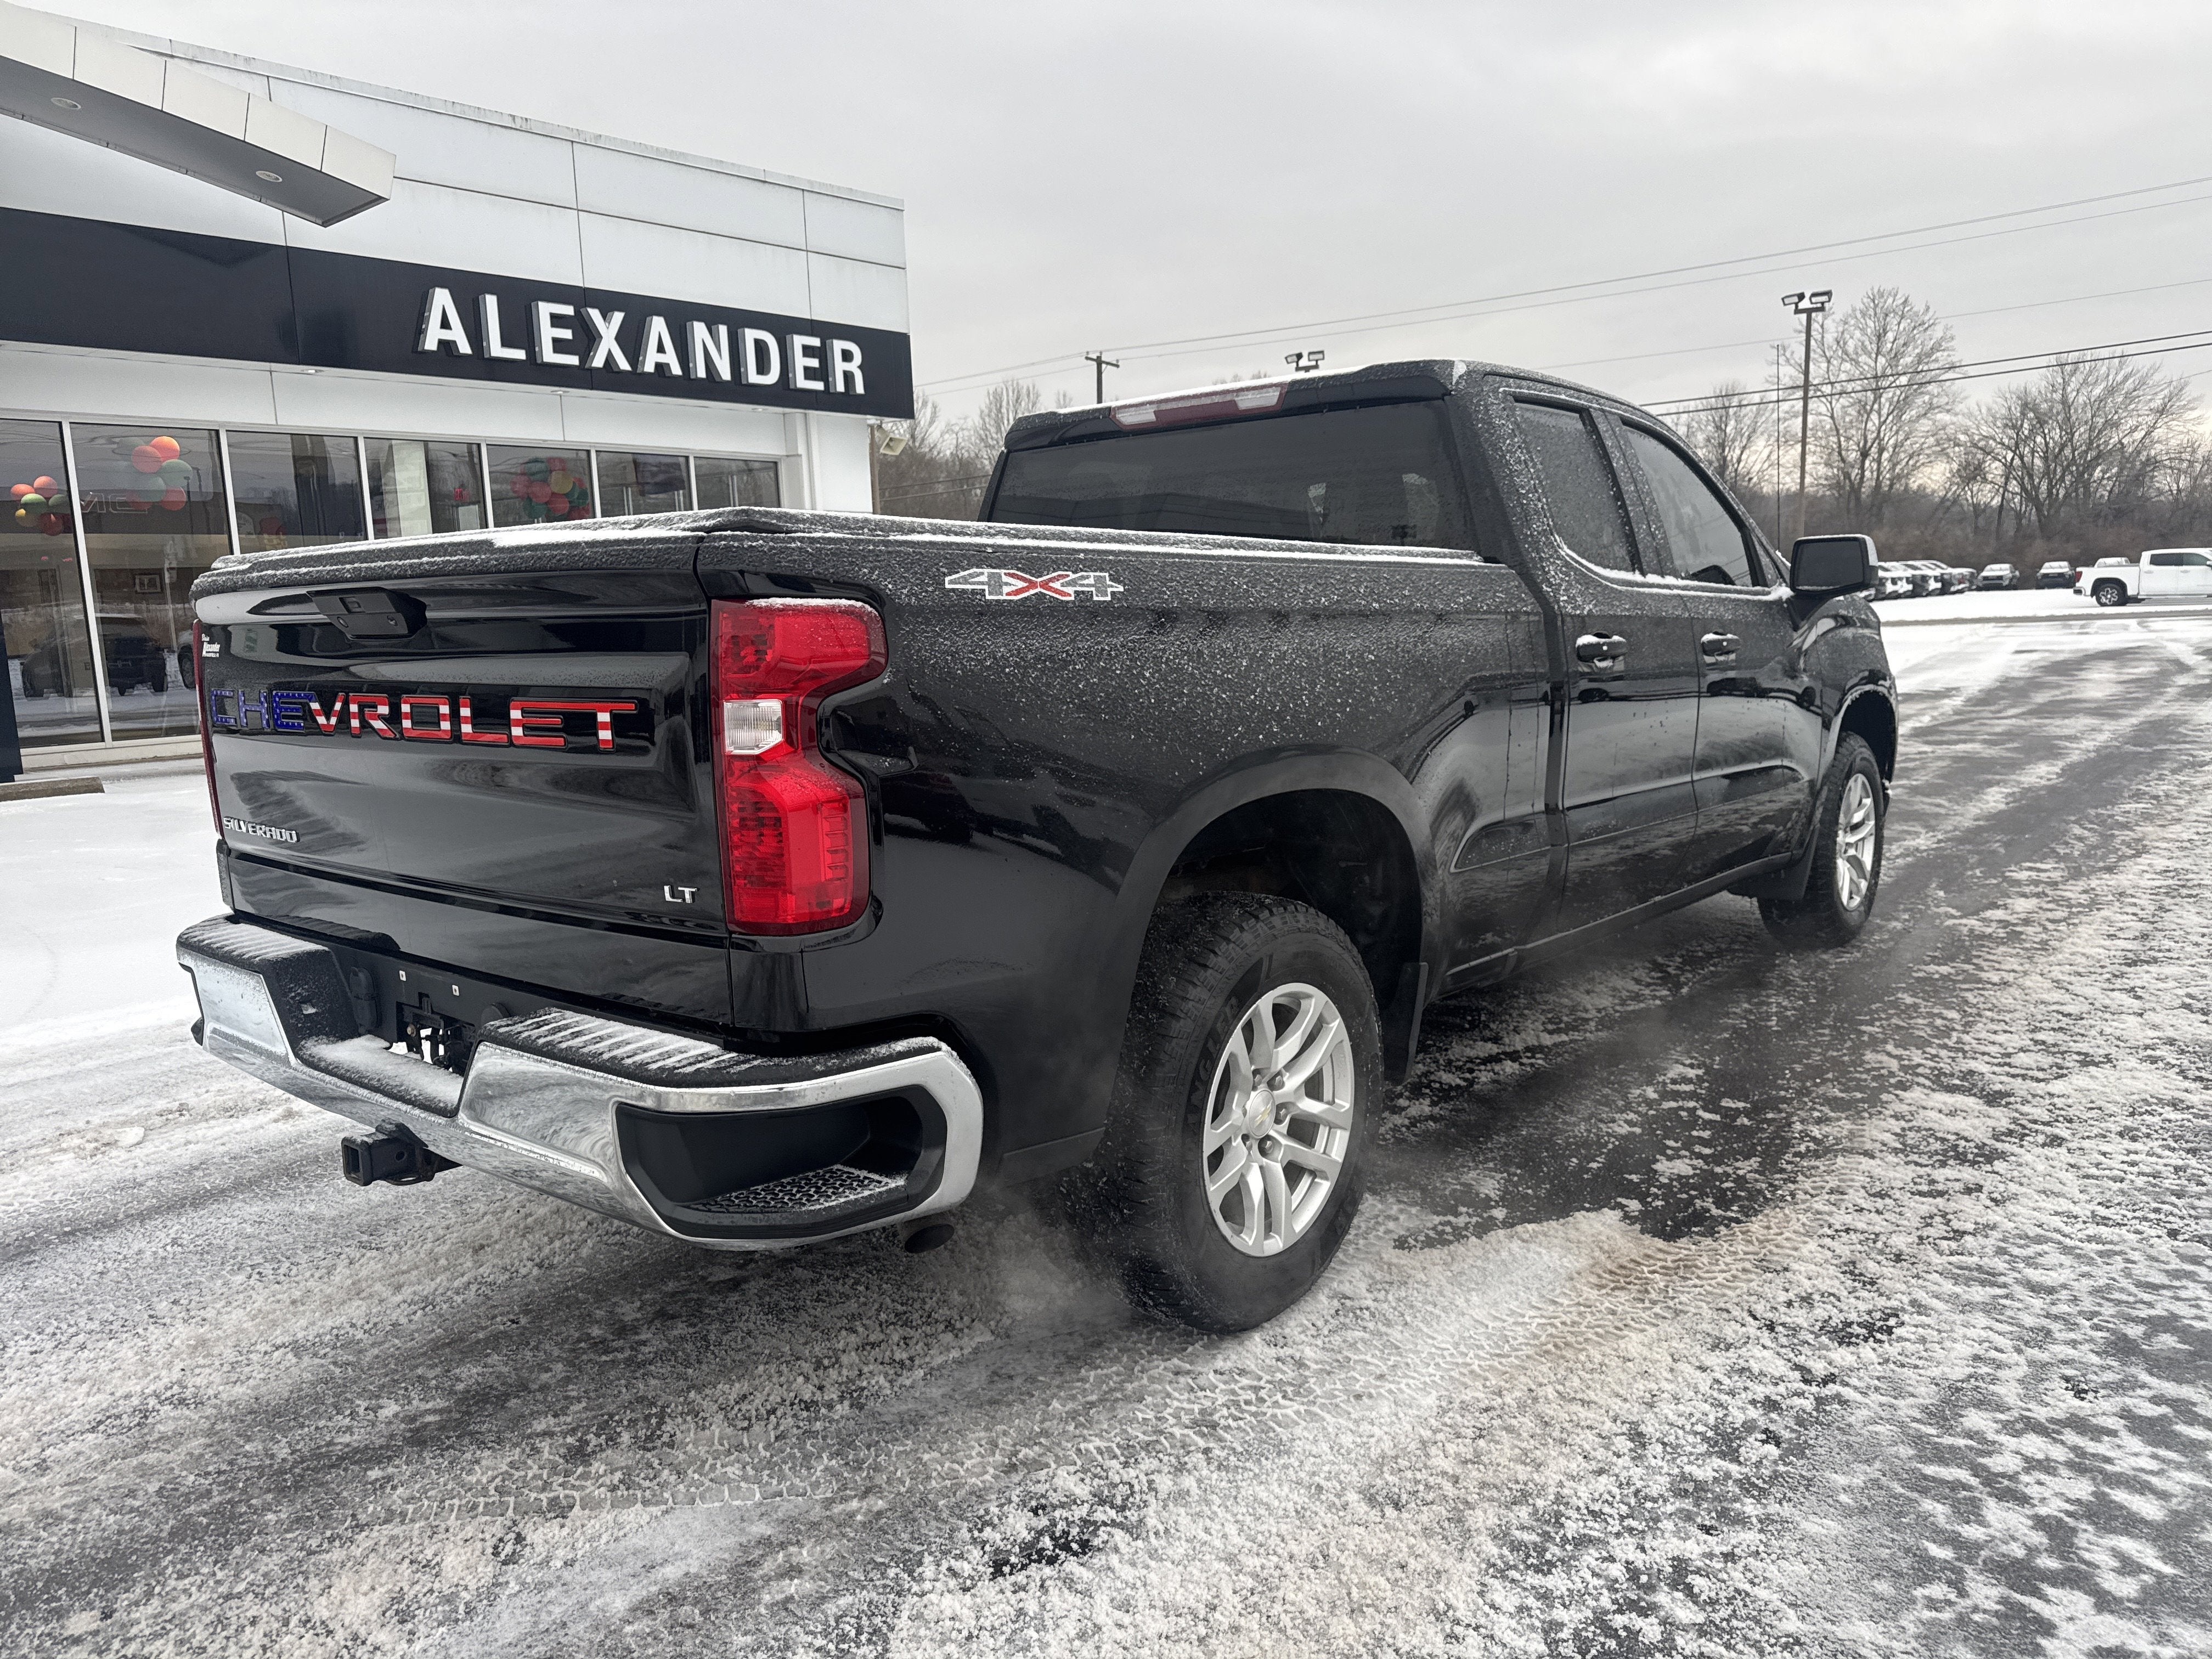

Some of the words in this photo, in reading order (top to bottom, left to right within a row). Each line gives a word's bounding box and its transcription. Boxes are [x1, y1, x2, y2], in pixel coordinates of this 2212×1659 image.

[418, 287, 865, 395] ALEXANDER
[210, 688, 638, 752] CHEVROLET
[223, 817, 300, 843] SILVERADO
[664, 885, 698, 904] LT
